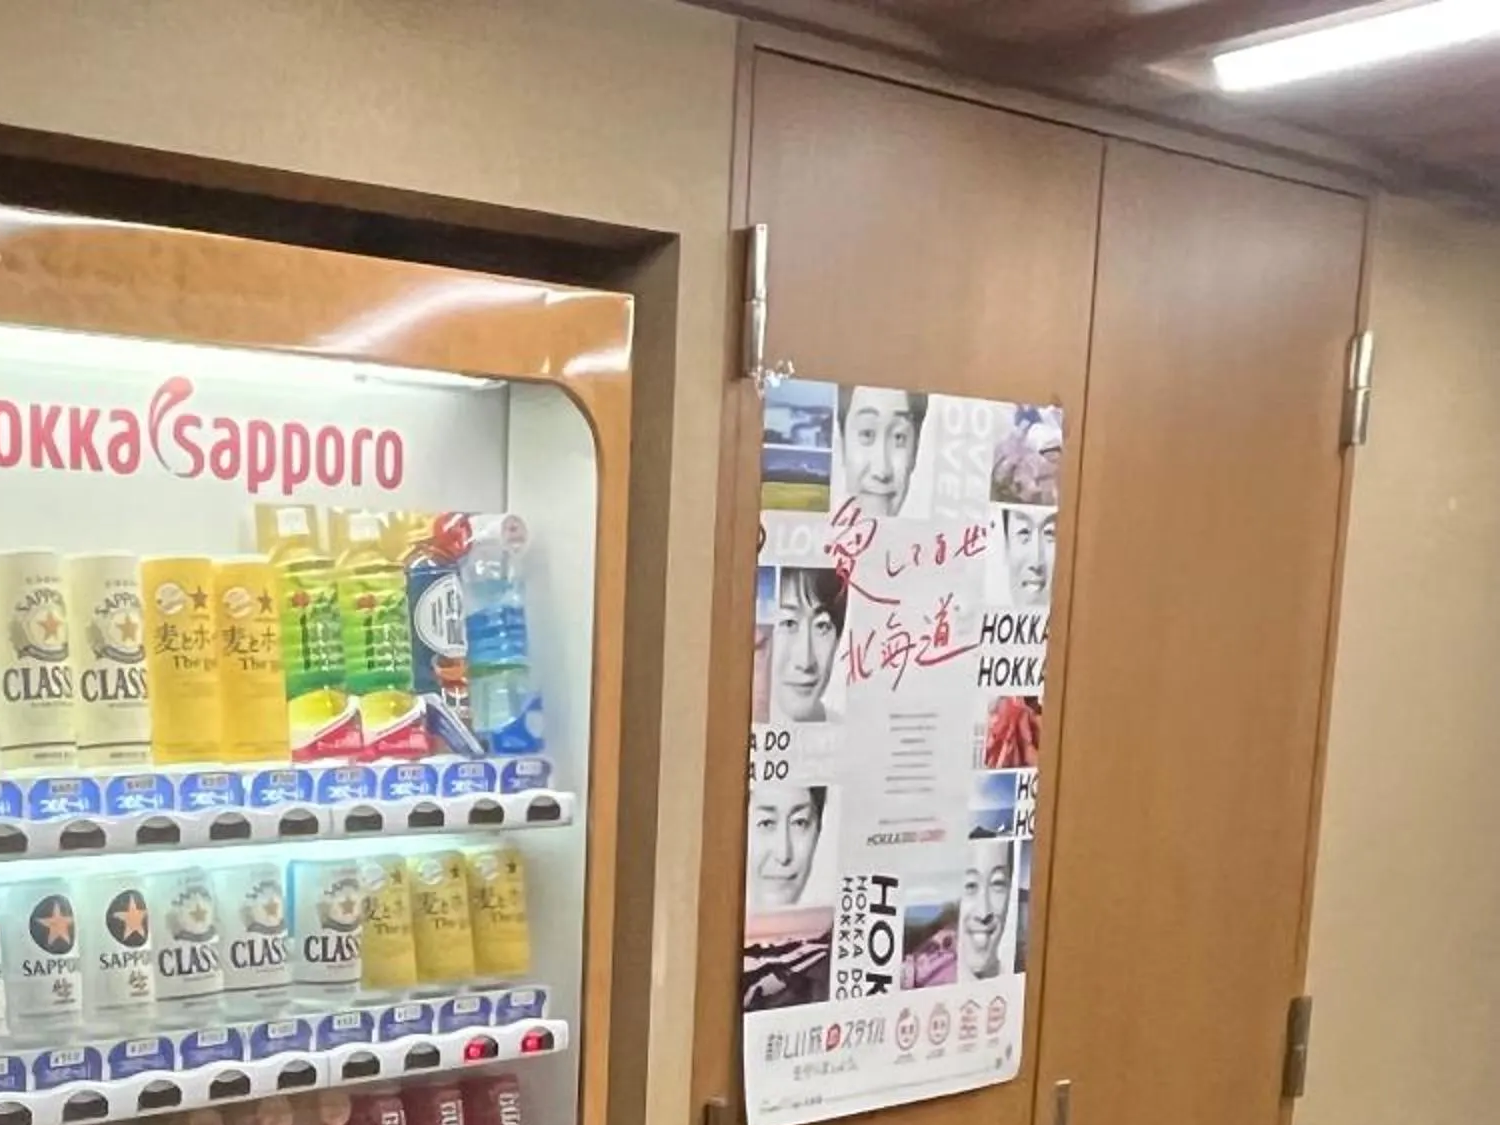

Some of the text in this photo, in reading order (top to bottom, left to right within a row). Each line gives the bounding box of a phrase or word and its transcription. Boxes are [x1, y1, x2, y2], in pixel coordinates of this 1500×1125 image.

[840, 592, 980, 691] 北海道
[866, 875, 899, 997] HOK
